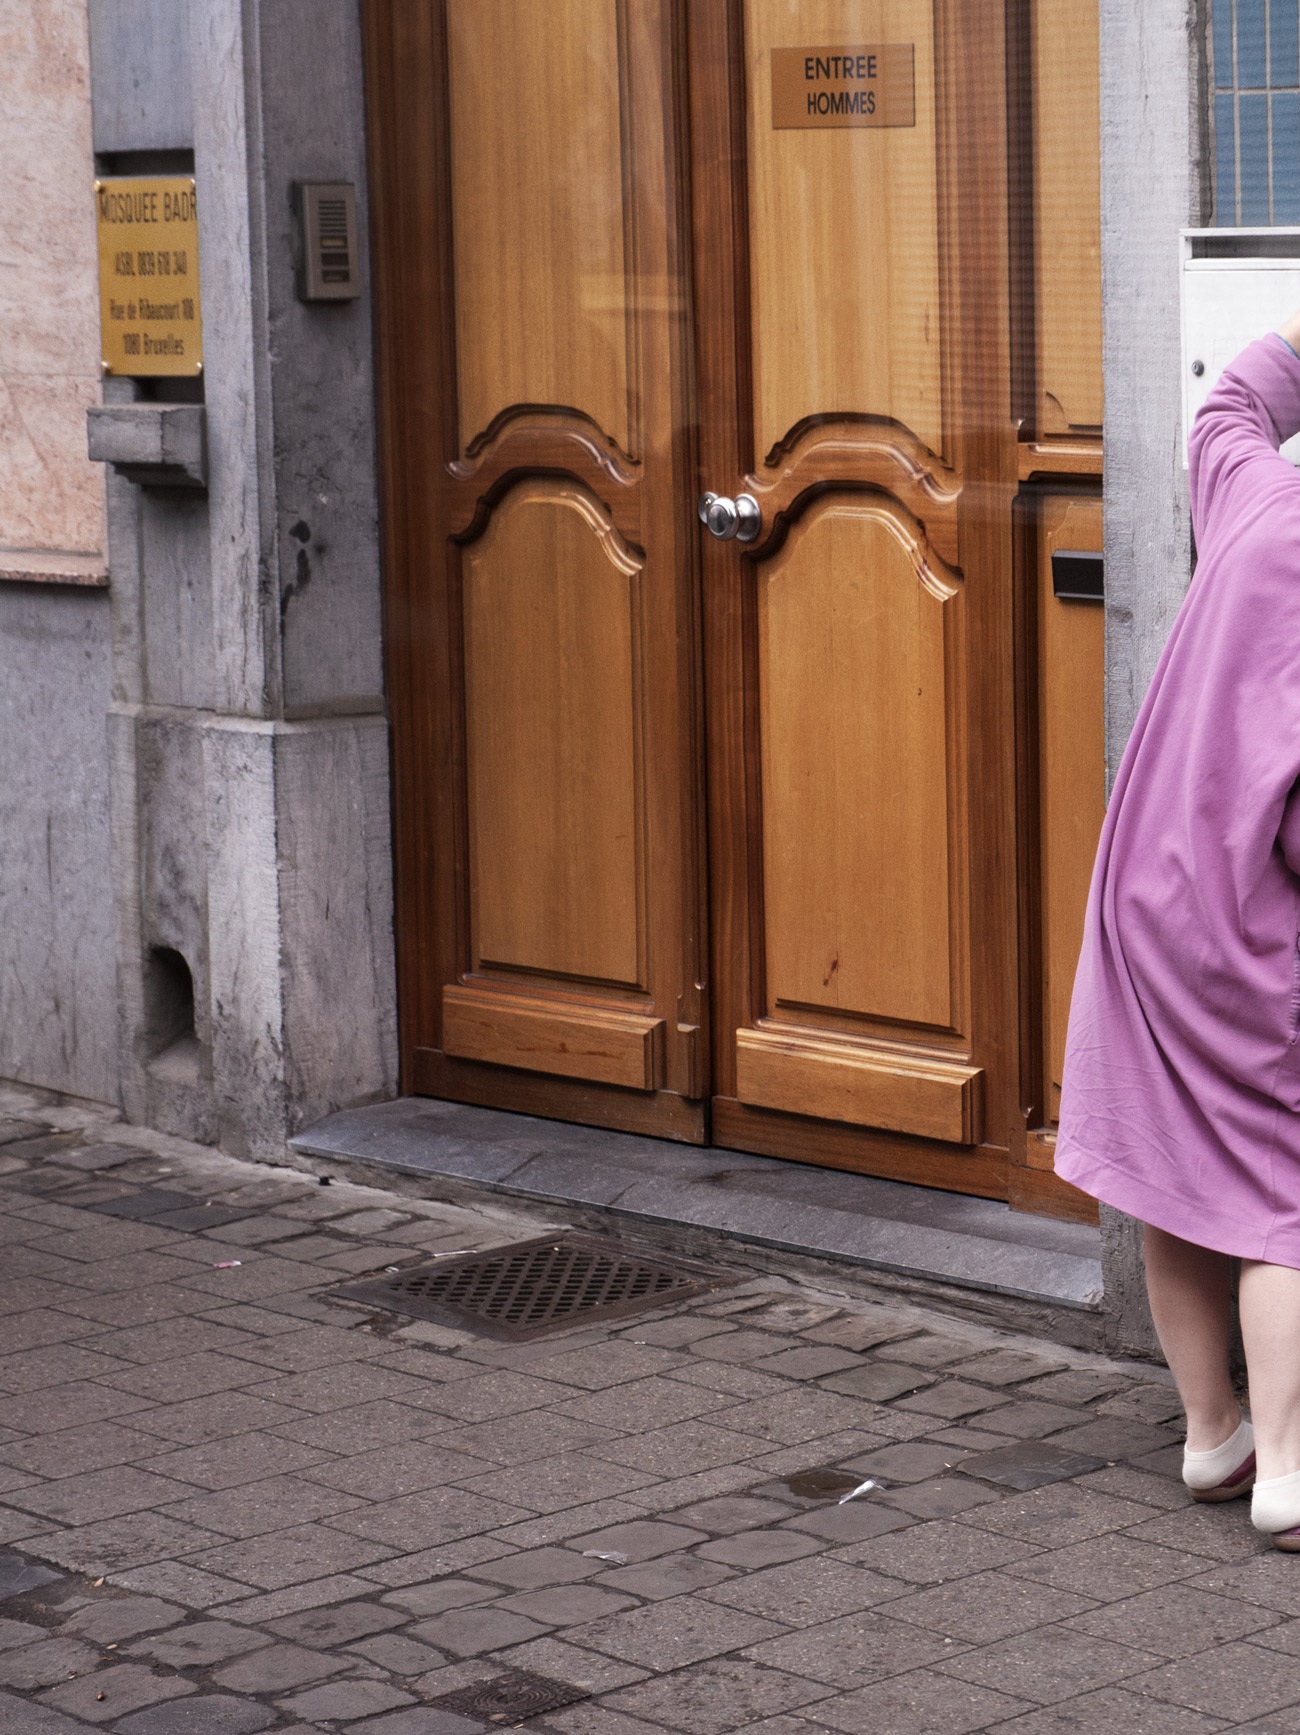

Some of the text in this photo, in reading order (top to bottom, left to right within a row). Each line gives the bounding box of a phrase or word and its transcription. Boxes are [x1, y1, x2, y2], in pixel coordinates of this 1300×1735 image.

[804, 55, 877, 80] ENTREE
[807, 90, 876, 115] HOMMES
[100, 190, 197, 224] MOSQUEE BADR
[109, 299, 125, 320] Rue
[127, 299, 137, 320] de
[143, 333, 185, 356] Bruxelles
